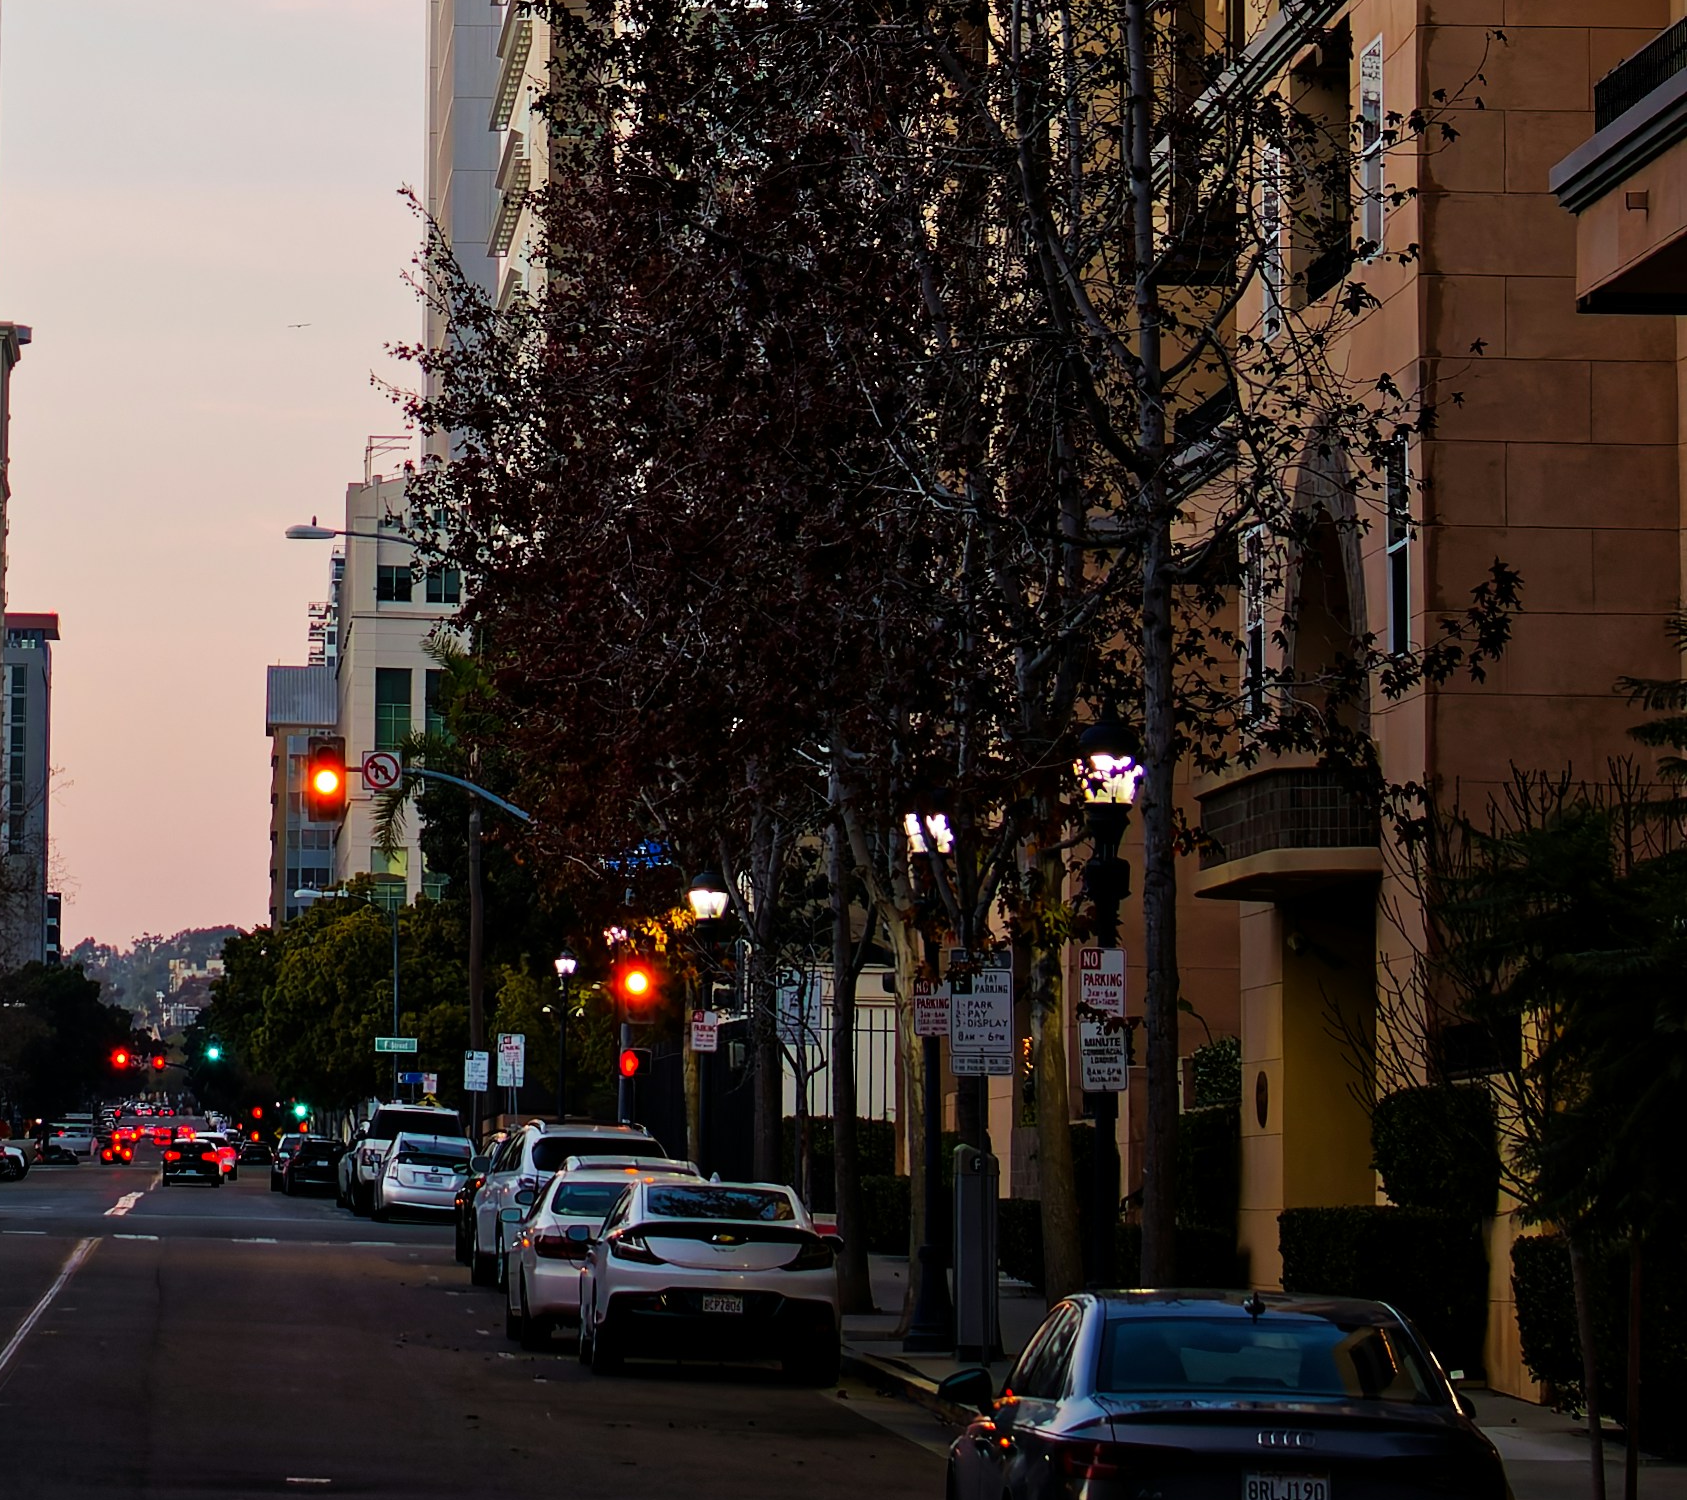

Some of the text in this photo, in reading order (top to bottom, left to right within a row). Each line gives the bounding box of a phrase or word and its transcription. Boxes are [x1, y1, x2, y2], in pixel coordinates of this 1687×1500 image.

[1083, 951, 1098, 967] NO
[984, 974, 997, 983] PAY
[1083, 973, 1122, 987] PARKING
[916, 980, 929, 994] NO
[974, 984, 1008, 993] PARKING
[916, 998, 949, 1009] PARKING
[967, 1001, 993, 1009] PARK
[967, 1010, 987, 1018] PAY
[967, 1019, 1008, 1028] DISPLAY
[958, 1031, 975, 1041] 8AM
[988, 1032, 1005, 1041] 6PM
[1084, 1037, 1120, 1047] MINUTE
[1082, 1048, 1123, 1056] COMMERCIAL
[1090, 1056, 1118, 1064] LOADING
